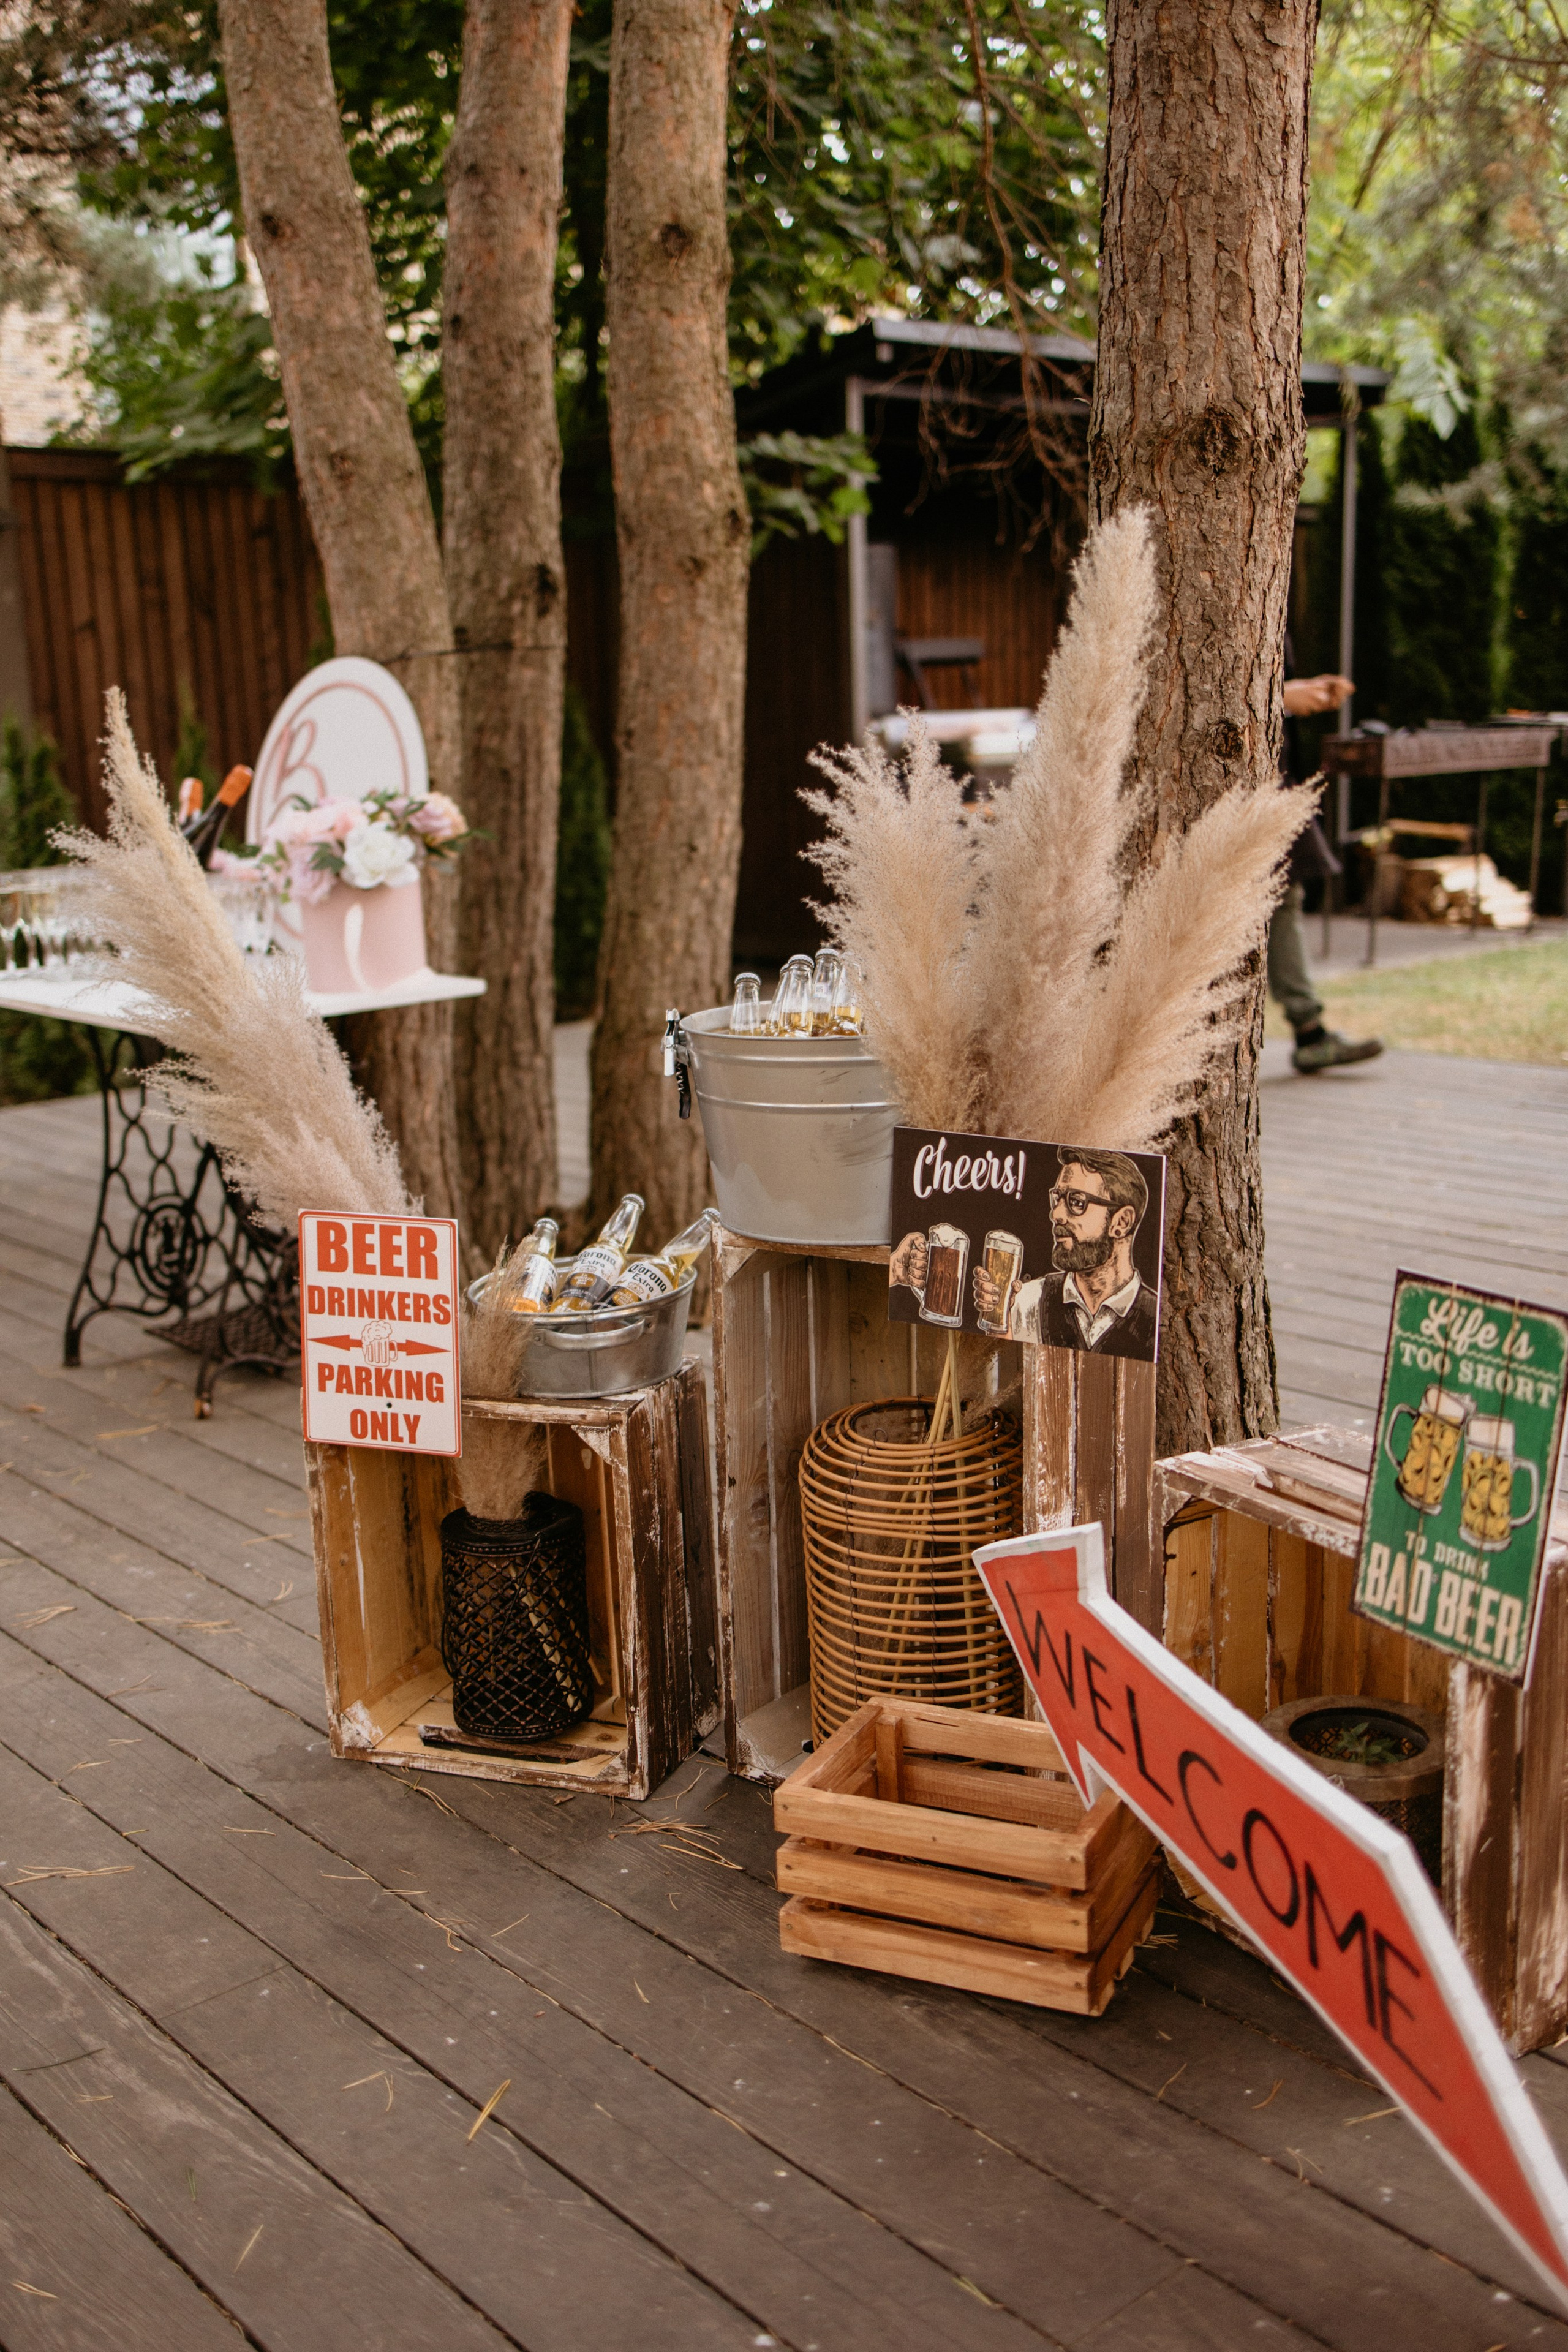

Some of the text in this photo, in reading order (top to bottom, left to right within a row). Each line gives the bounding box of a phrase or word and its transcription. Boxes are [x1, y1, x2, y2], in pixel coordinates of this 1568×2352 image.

[913, 1136, 1027, 1201] Cheers!
[316, 1220, 439, 1280] BEER
[577, 1251, 616, 1267] Corona
[581, 1257, 605, 1268] Extra
[628, 1263, 667, 1293] Corona
[631, 1273, 654, 1292] Extra
[307, 1284, 451, 1325] DRINKERS
[1420, 1297, 1536, 1360] Life is
[317, 1362, 445, 1403] PARKING
[1399, 1341, 1558, 1408] TOO SHORT
[350, 1408, 421, 1444] ONLY
[1405, 1530, 1490, 1582] TO DRINK
[1364, 1541, 1523, 1665] BAD BEER
[1006, 1581, 1442, 2102] WELCOME
